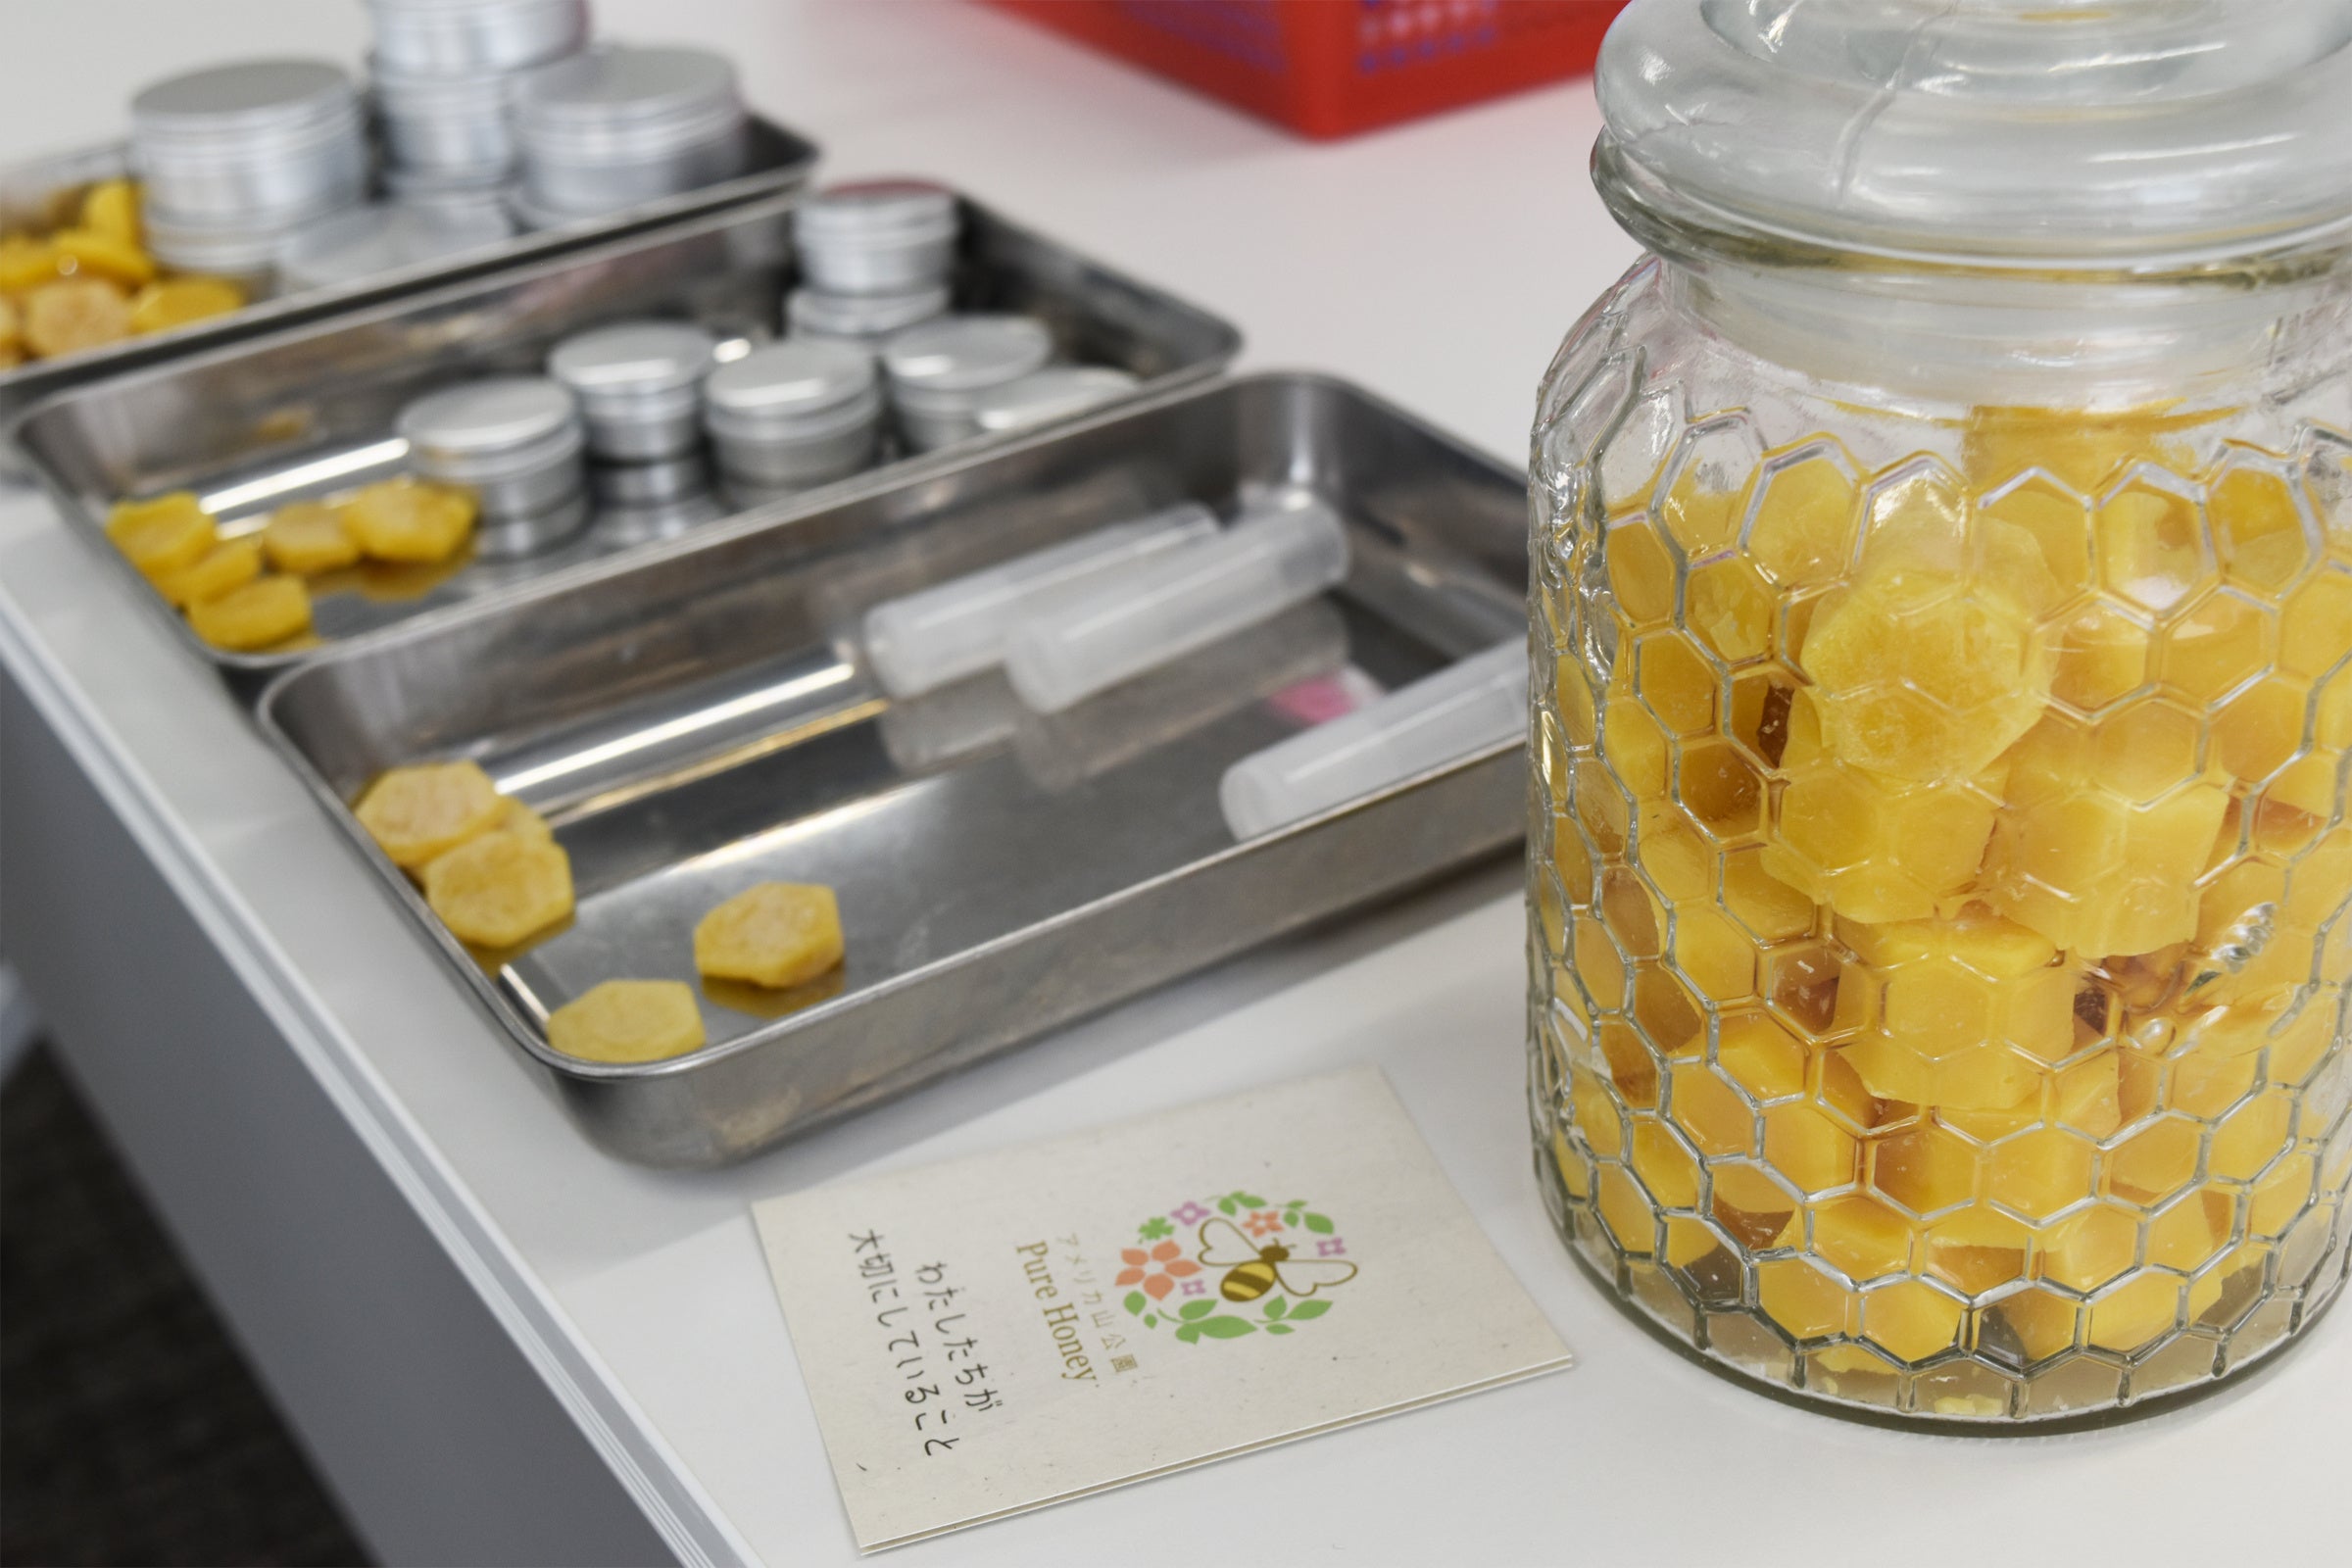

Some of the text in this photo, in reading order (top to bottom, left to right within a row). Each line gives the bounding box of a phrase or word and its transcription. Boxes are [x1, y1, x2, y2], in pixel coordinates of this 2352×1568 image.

[848, 1228, 960, 1457] 大切にしていること
[914, 1260, 1004, 1412] わたしたちが
[1015, 1240, 1098, 1382] Pure Honey
[1055, 1232, 1139, 1374] アメリカ山公園
